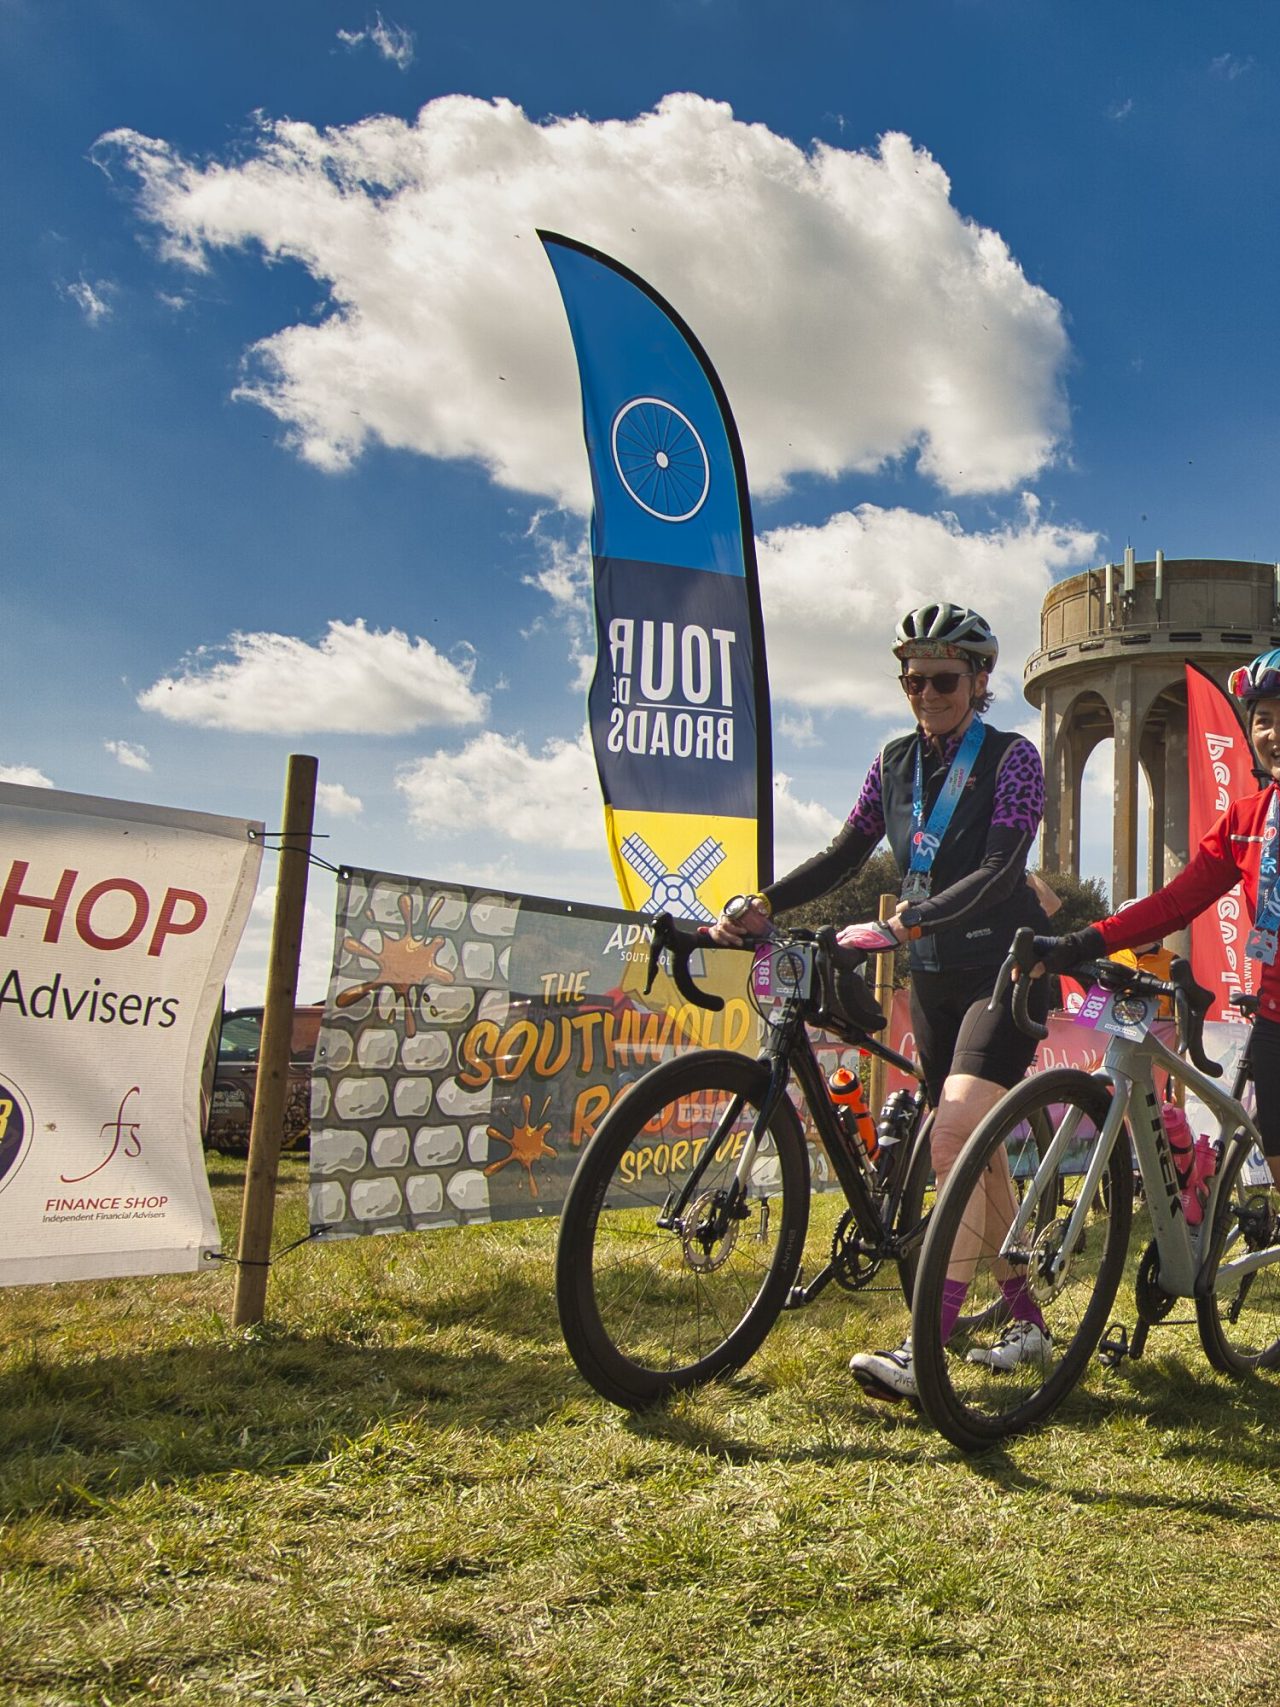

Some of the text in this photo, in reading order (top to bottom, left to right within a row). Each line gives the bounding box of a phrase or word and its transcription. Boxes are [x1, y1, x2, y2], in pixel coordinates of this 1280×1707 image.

[0, 860, 208, 957] HOP
[603, 923, 656, 955] ADN
[621, 951, 671, 966] SOUTHOL
[758, 960, 770, 986] 186
[0, 970, 180, 1028] Advisers
[541, 971, 590, 1005] THE
[1083, 995, 1106, 1019] 188
[458, 998, 750, 1088] SOUTHWOLD
[620, 1130, 748, 1183] SPORTVE
[42, 1211, 166, 1223] Independent Financial Advisers
[45, 1196, 168, 1211] FINANCE SHOP
